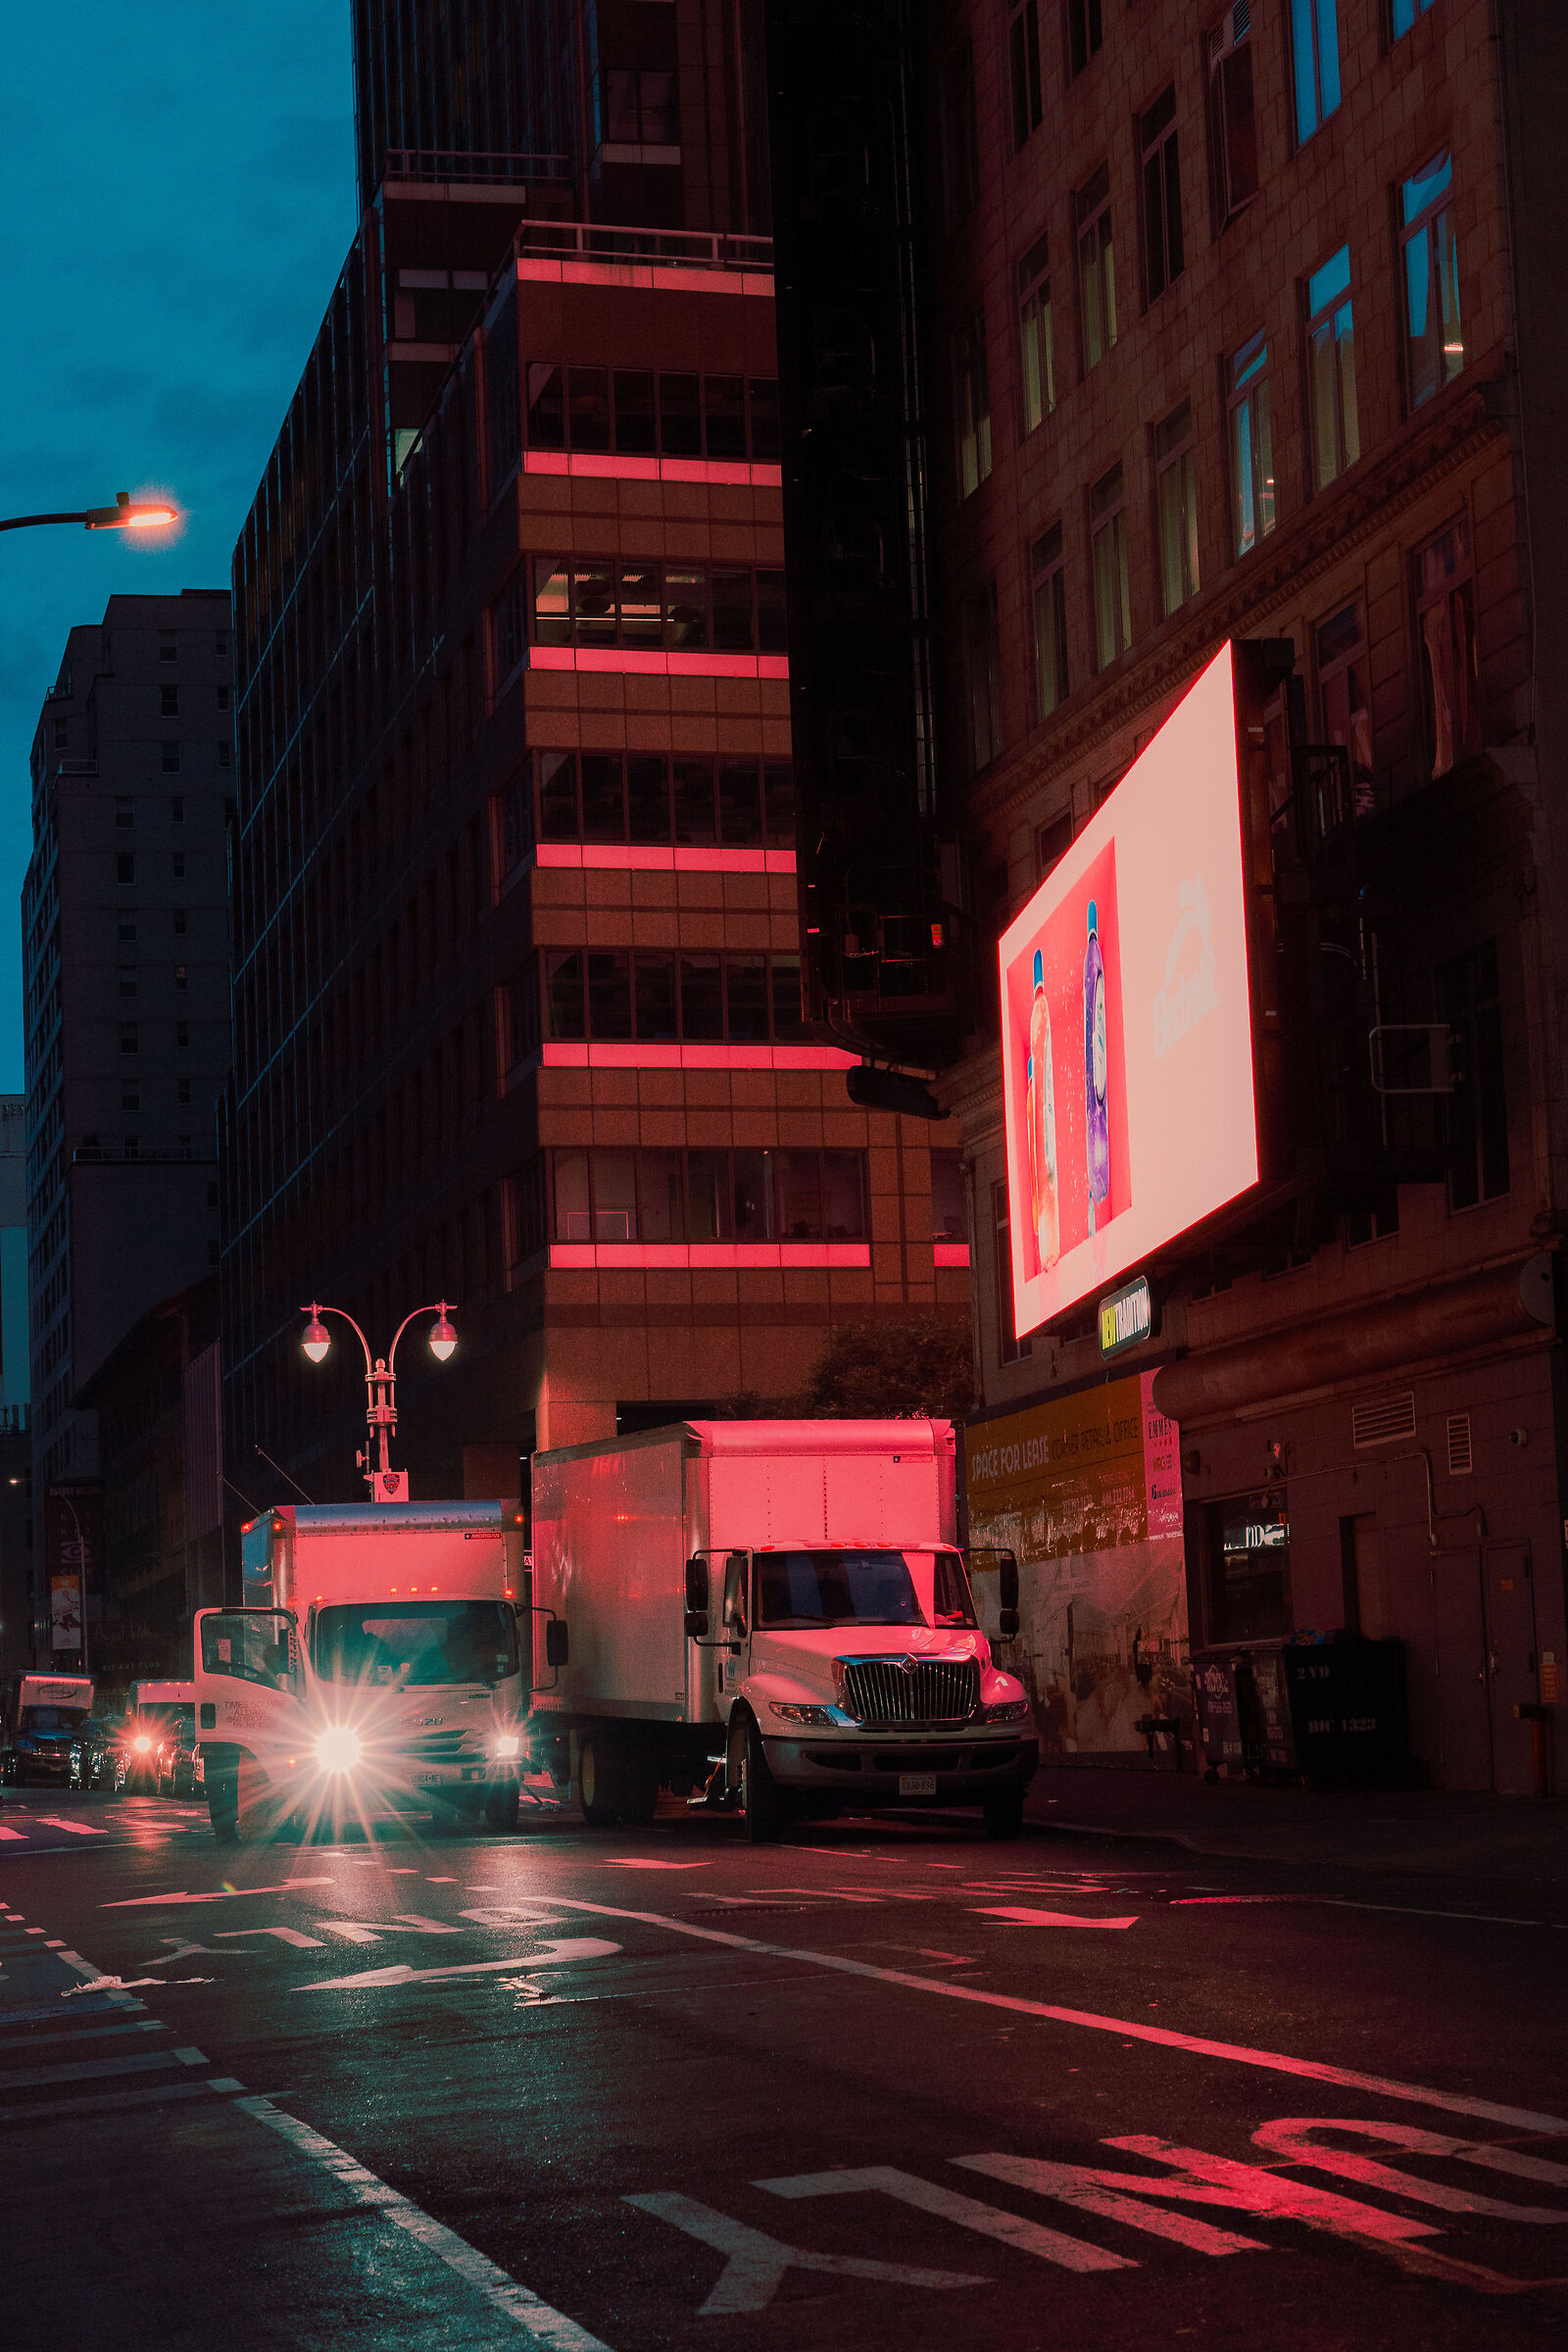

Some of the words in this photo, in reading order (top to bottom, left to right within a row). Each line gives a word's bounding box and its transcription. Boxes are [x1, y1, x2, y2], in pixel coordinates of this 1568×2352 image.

[971, 1447, 999, 1482] SPACE
[1000, 1444, 1022, 1474] FOR
[1022, 1434, 1050, 1470] LEASE
[1052, 1433, 1080, 1461] CORNER
[1113, 1417, 1139, 1443] OFFICE
[138, 1661, 161, 1670] CLUB
[223, 1700, 249, 1709] TIMES
[251, 1699, 286, 1708] SQUARE
[399, 1717, 446, 1726] ISUZU
[138, 1907, 570, 1967] ONLY
[618, 2116, 1568, 2316] ONLY
